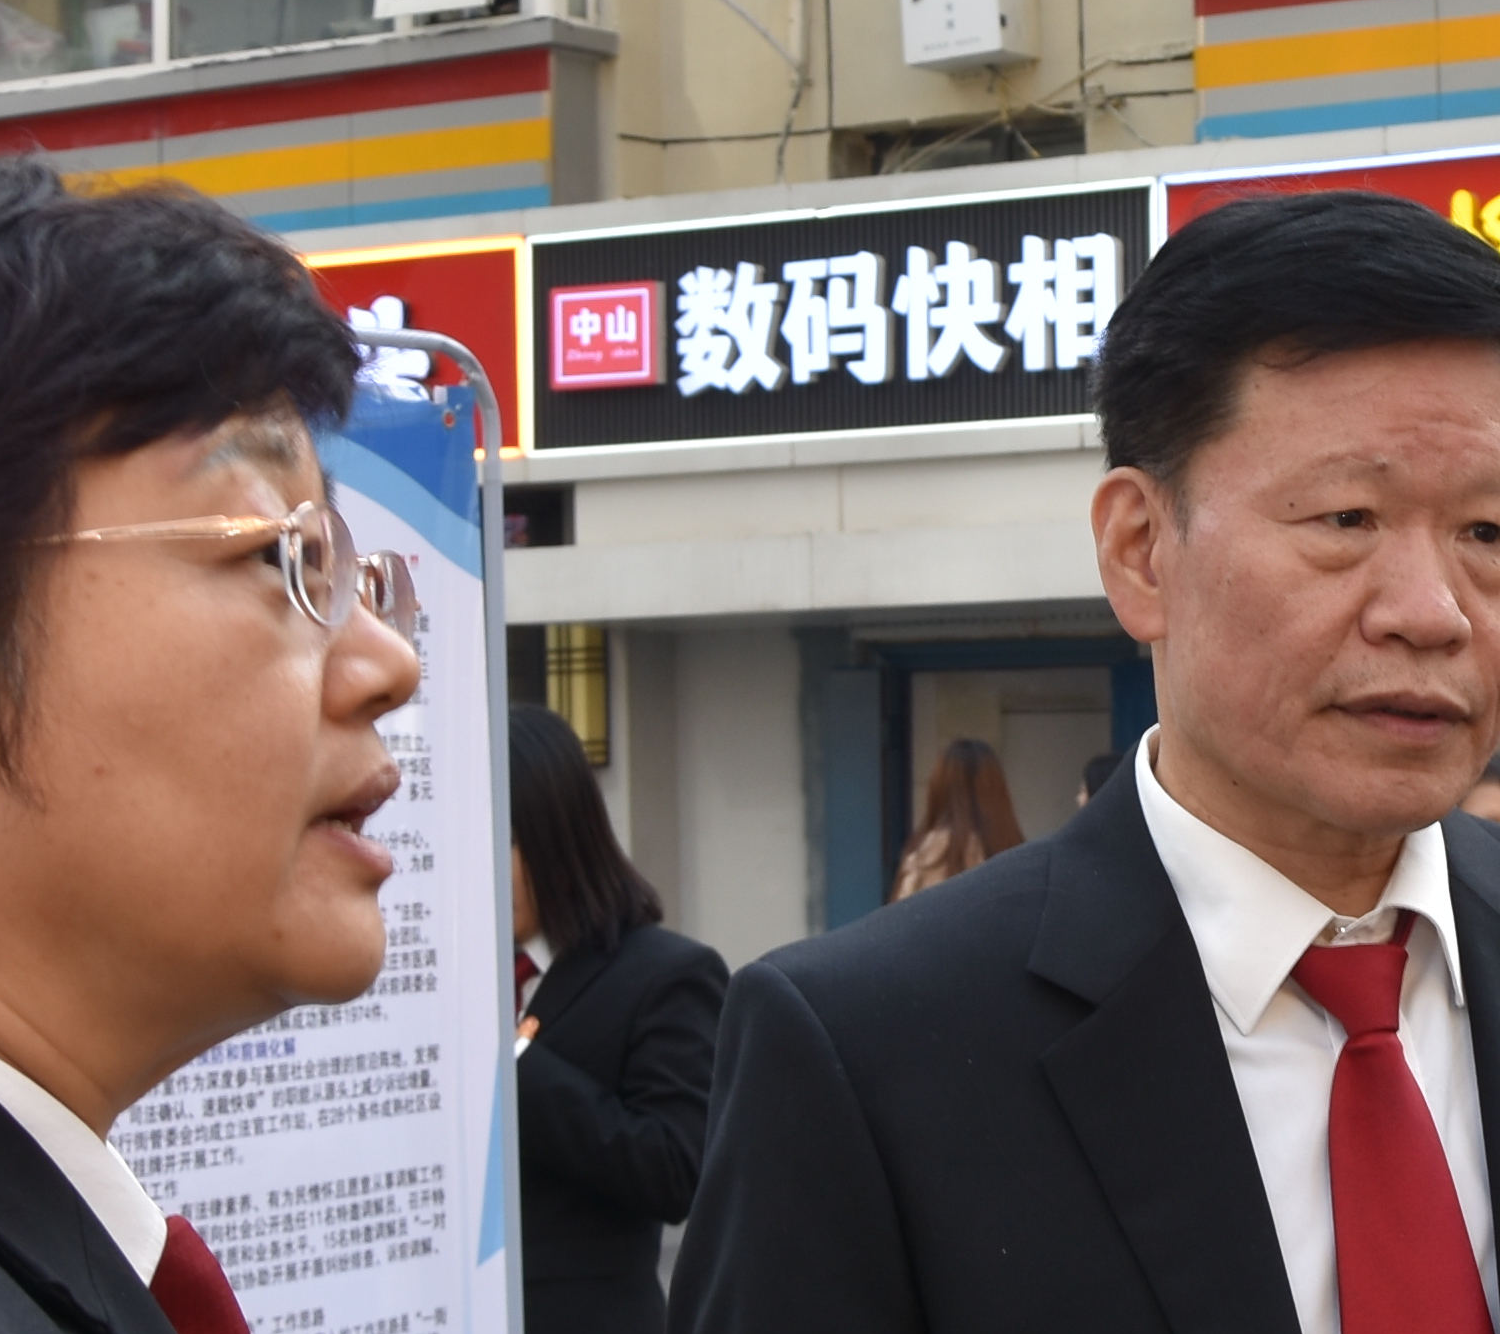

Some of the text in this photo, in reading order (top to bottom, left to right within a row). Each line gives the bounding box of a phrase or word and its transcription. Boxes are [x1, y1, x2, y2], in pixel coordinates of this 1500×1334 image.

[570, 306, 637, 346] 中山
[676, 234, 1117, 397] 数码快相
